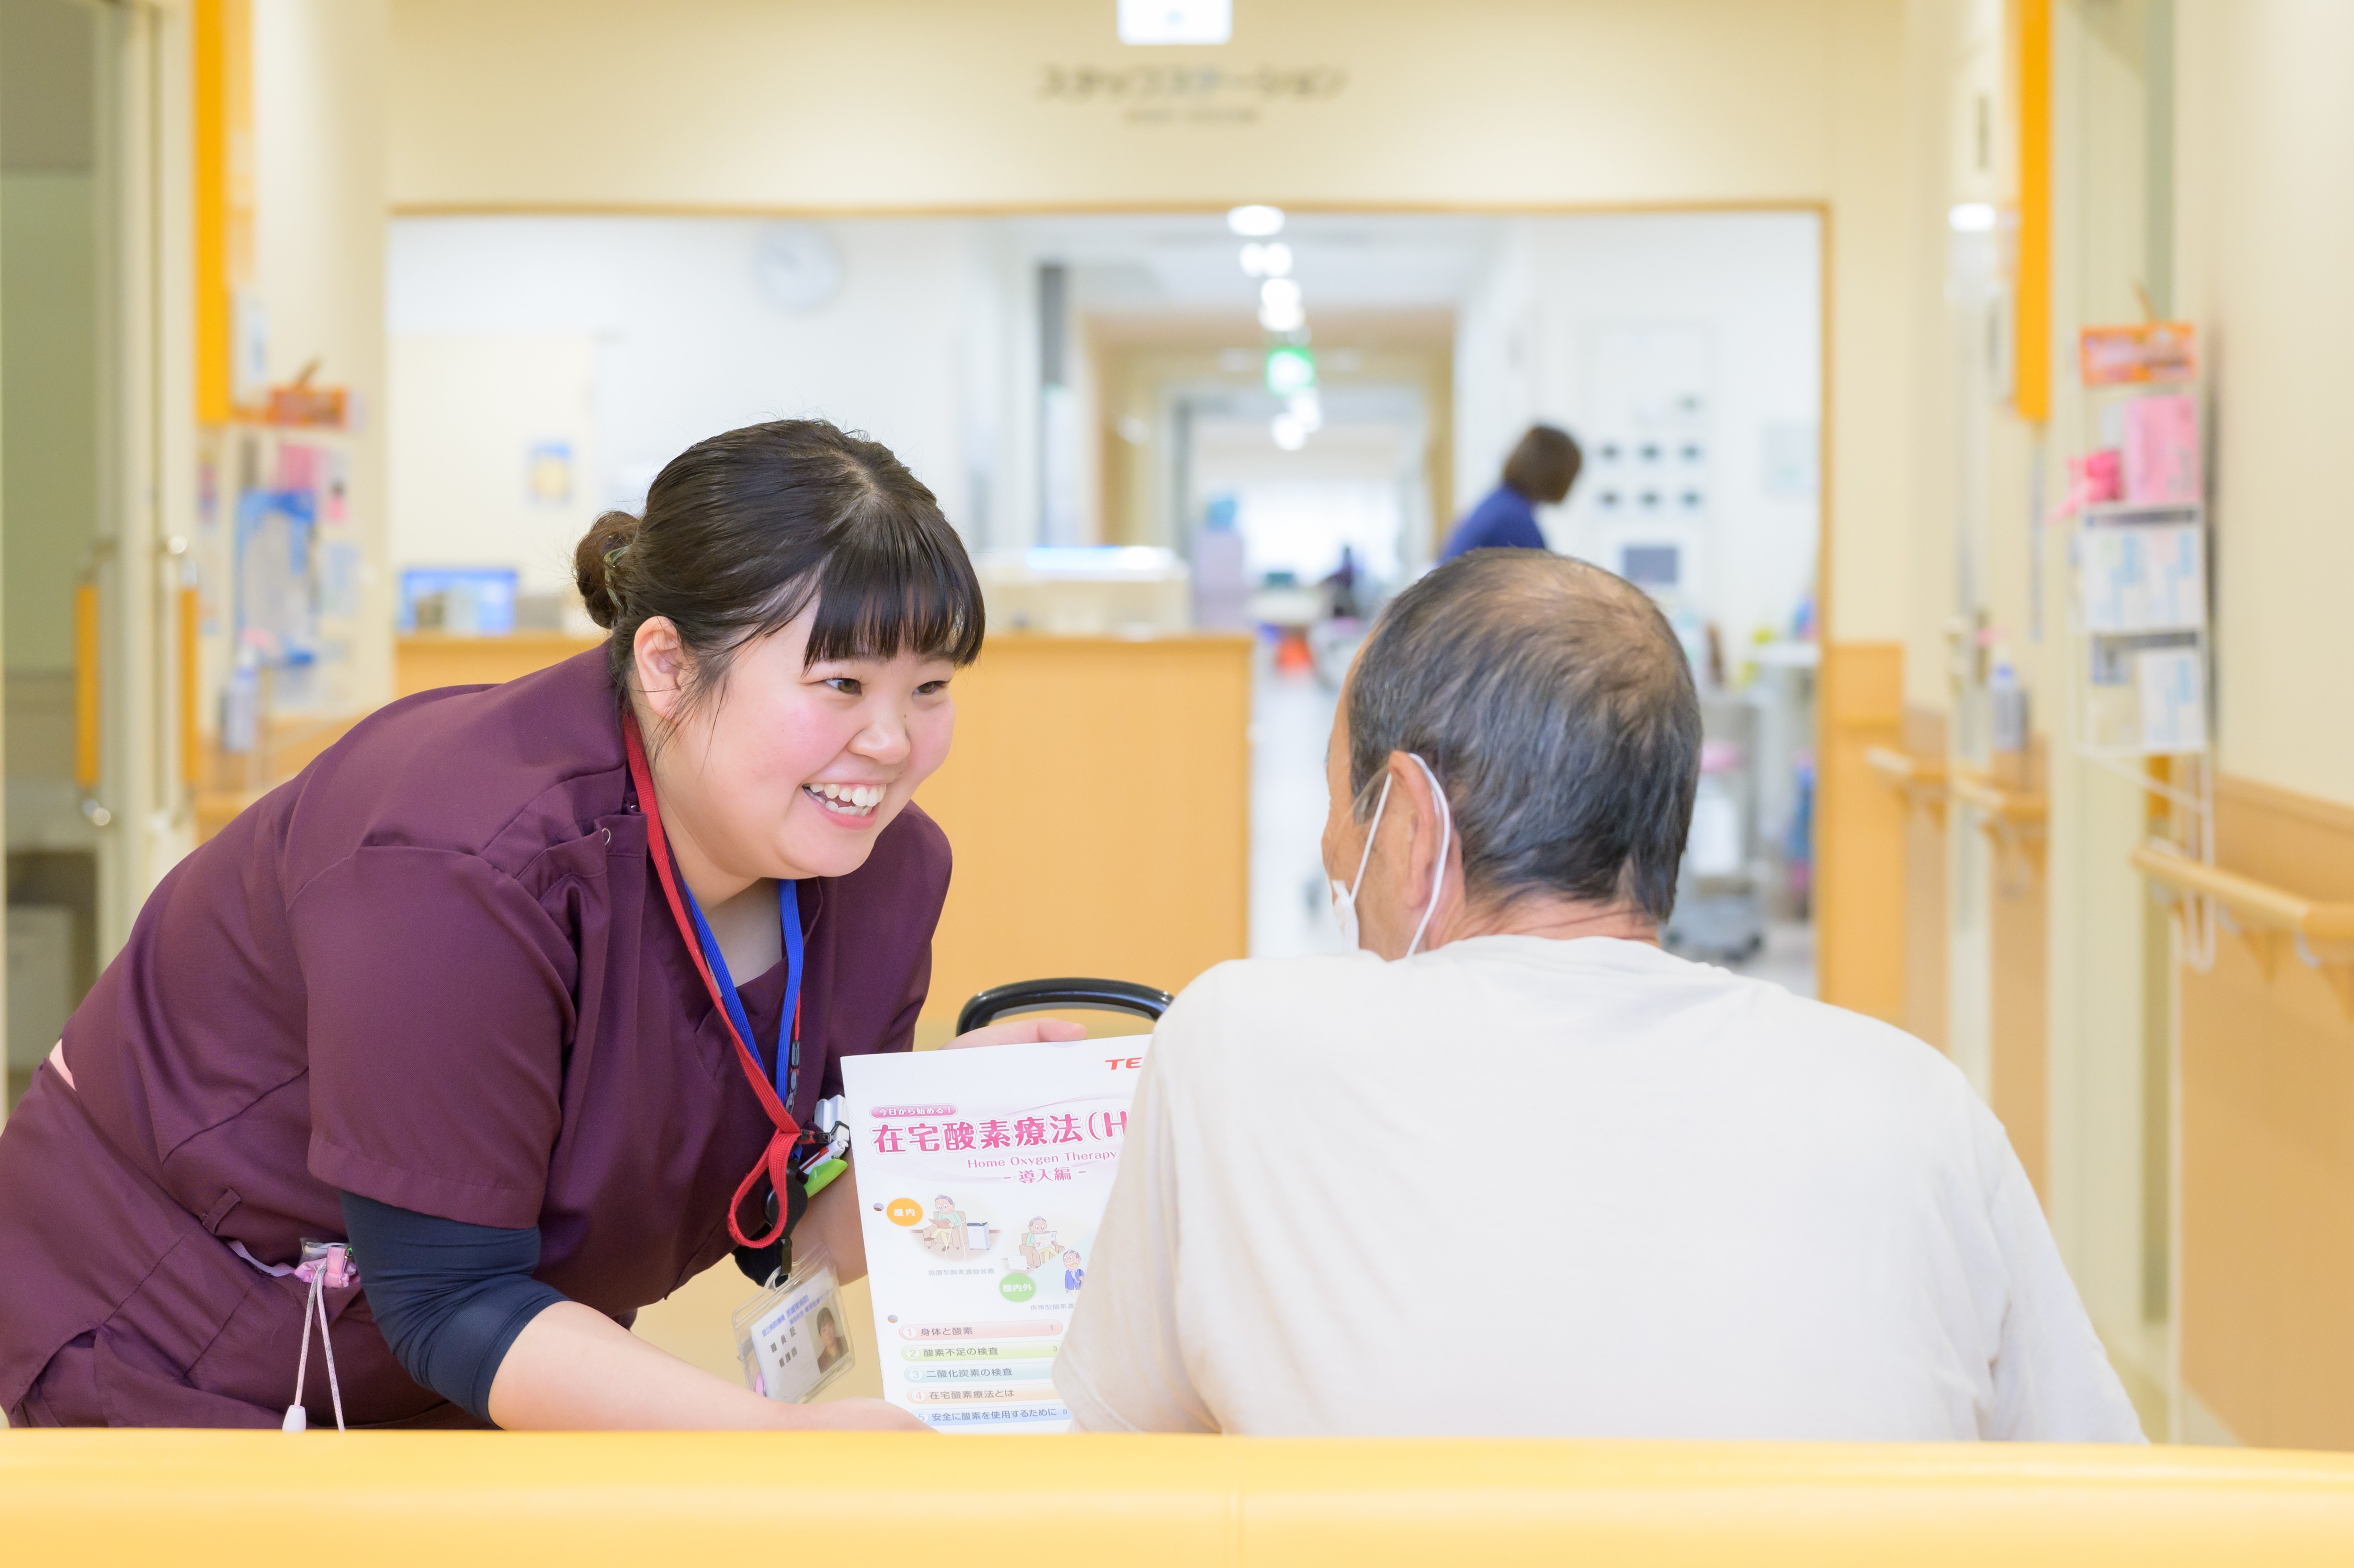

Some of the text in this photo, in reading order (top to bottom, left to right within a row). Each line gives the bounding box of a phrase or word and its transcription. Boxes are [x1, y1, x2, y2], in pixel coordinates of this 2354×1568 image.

[878, 1106, 952, 1116] 今日から始める！
[968, 1151, 1117, 1168] Home Oxygen Therapy
[1018, 1166, 1072, 1184] 導入編
[893, 1208, 915, 1217] 屋内
[1003, 1283, 1032, 1292] 屋内外
[921, 1327, 973, 1336] 身体と酸素
[923, 1347, 999, 1357] 酸素不足の検査
[926, 1368, 1012, 1378] 二酸化炭素の検査
[929, 1390, 1014, 1400] 在宅酸素療法とは
[932, 1408, 1057, 1422] 安全に酸素を使用するために
